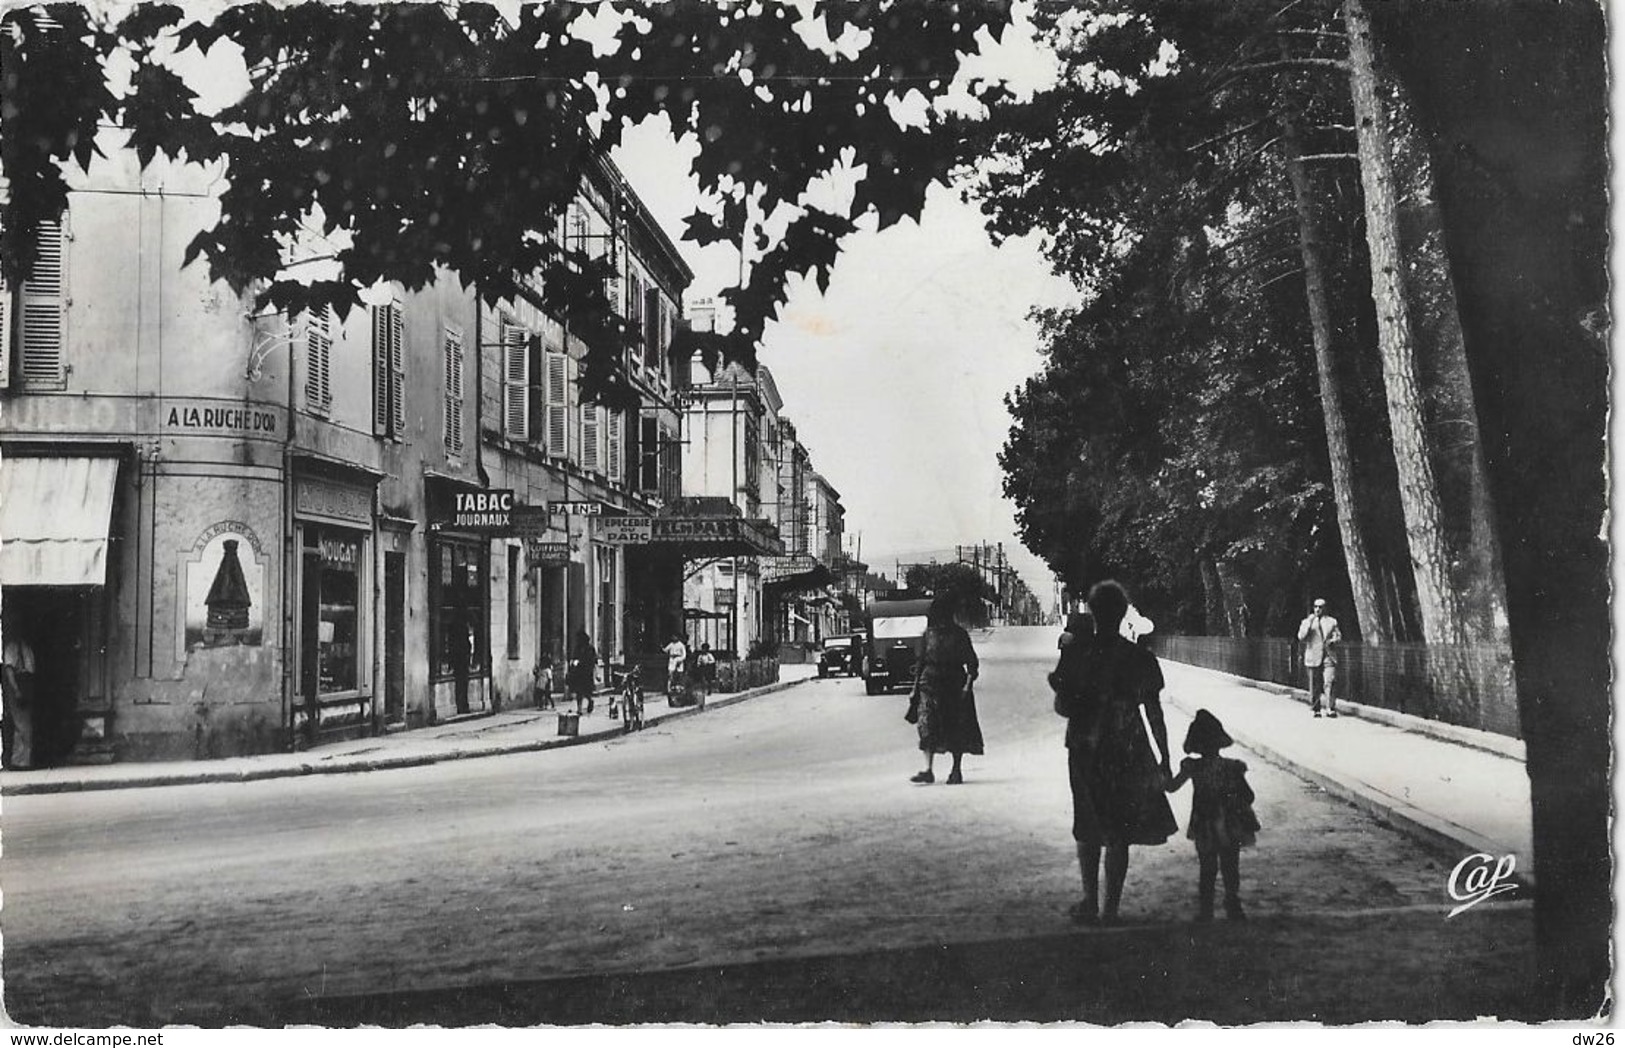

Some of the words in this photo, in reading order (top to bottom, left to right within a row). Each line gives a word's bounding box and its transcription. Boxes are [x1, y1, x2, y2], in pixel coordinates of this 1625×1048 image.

[168, 407, 179, 426] A
[183, 408, 200, 427] LA
[204, 408, 251, 430] RUCHE
[254, 411, 276, 432] D'OR
[456, 493, 511, 511] TABAC
[549, 503, 599, 515] BAINS
[453, 513, 510, 526] JOURNAUX
[605, 518, 651, 527] EPICERIE
[607, 533, 649, 541] PARC
[320, 540, 357, 563] NOUGAT
